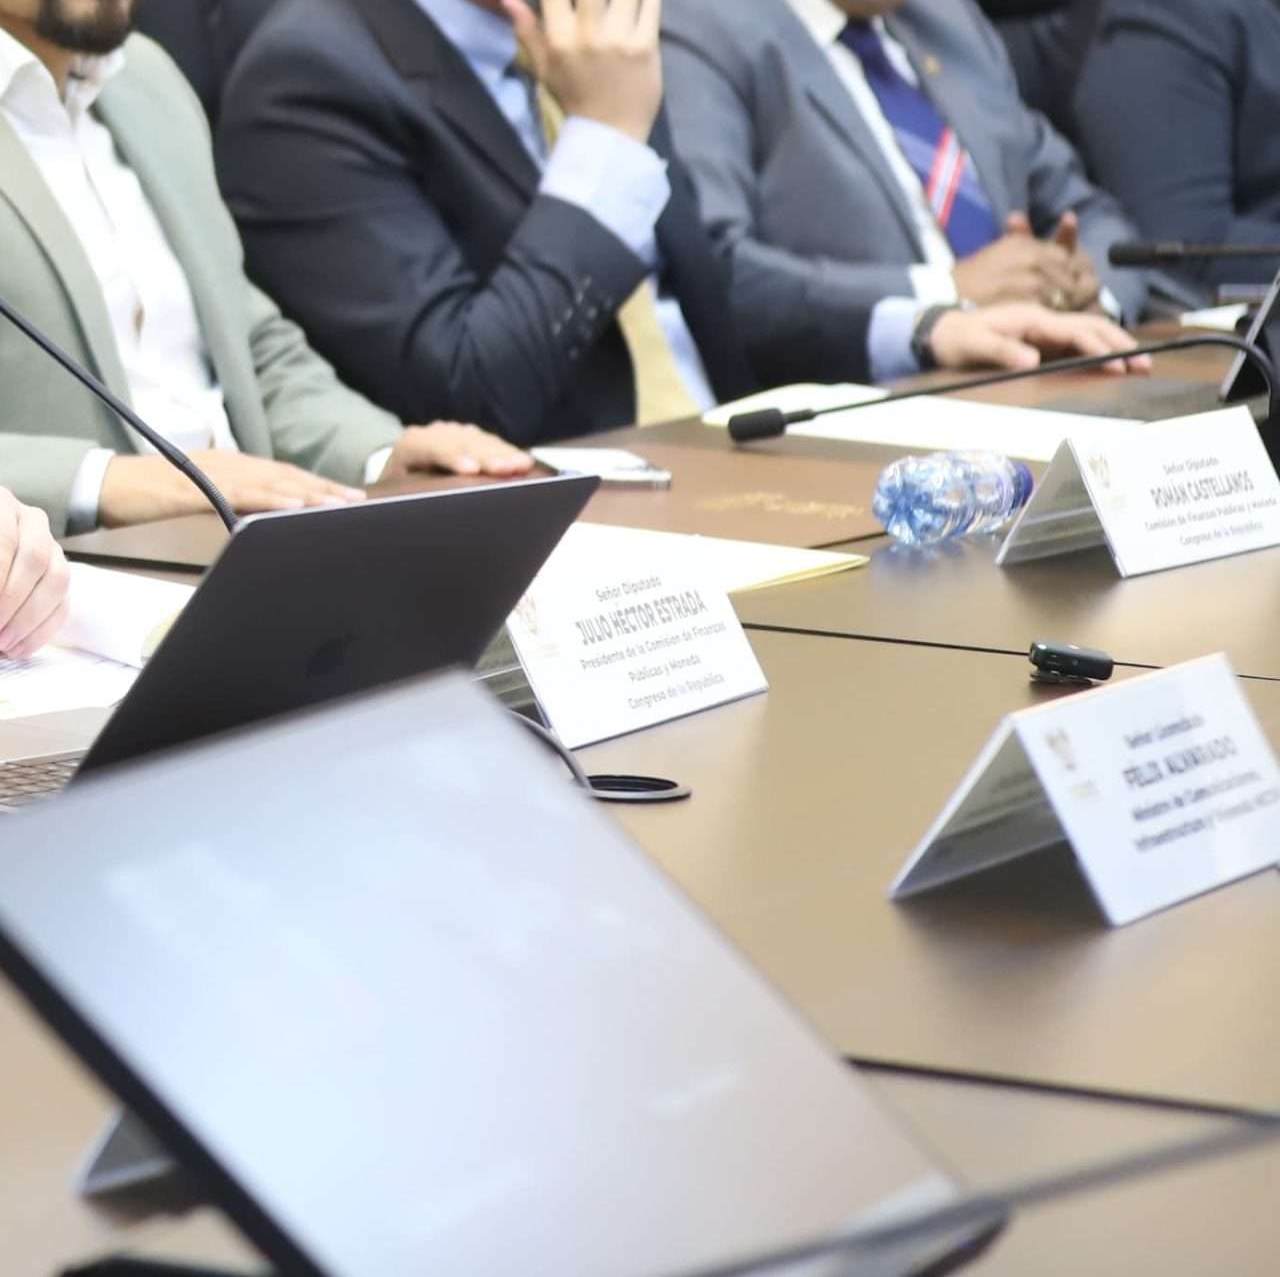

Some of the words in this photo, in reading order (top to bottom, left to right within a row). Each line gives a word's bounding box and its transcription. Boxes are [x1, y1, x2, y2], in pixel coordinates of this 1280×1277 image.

[1186, 469, 1256, 503] CASTELLANOS
[595, 584, 621, 603] Señor
[621, 575, 662, 596] Diputado
[575, 613, 614, 647] JULIO
[653, 589, 708, 626] ESTRADA
[580, 650, 626, 672] Presidente
[625, 646, 638, 659] de
[681, 629, 693, 643] de
[668, 653, 702, 672] Moneda
[627, 689, 667, 711] Congreso
[666, 685, 678, 699] de
